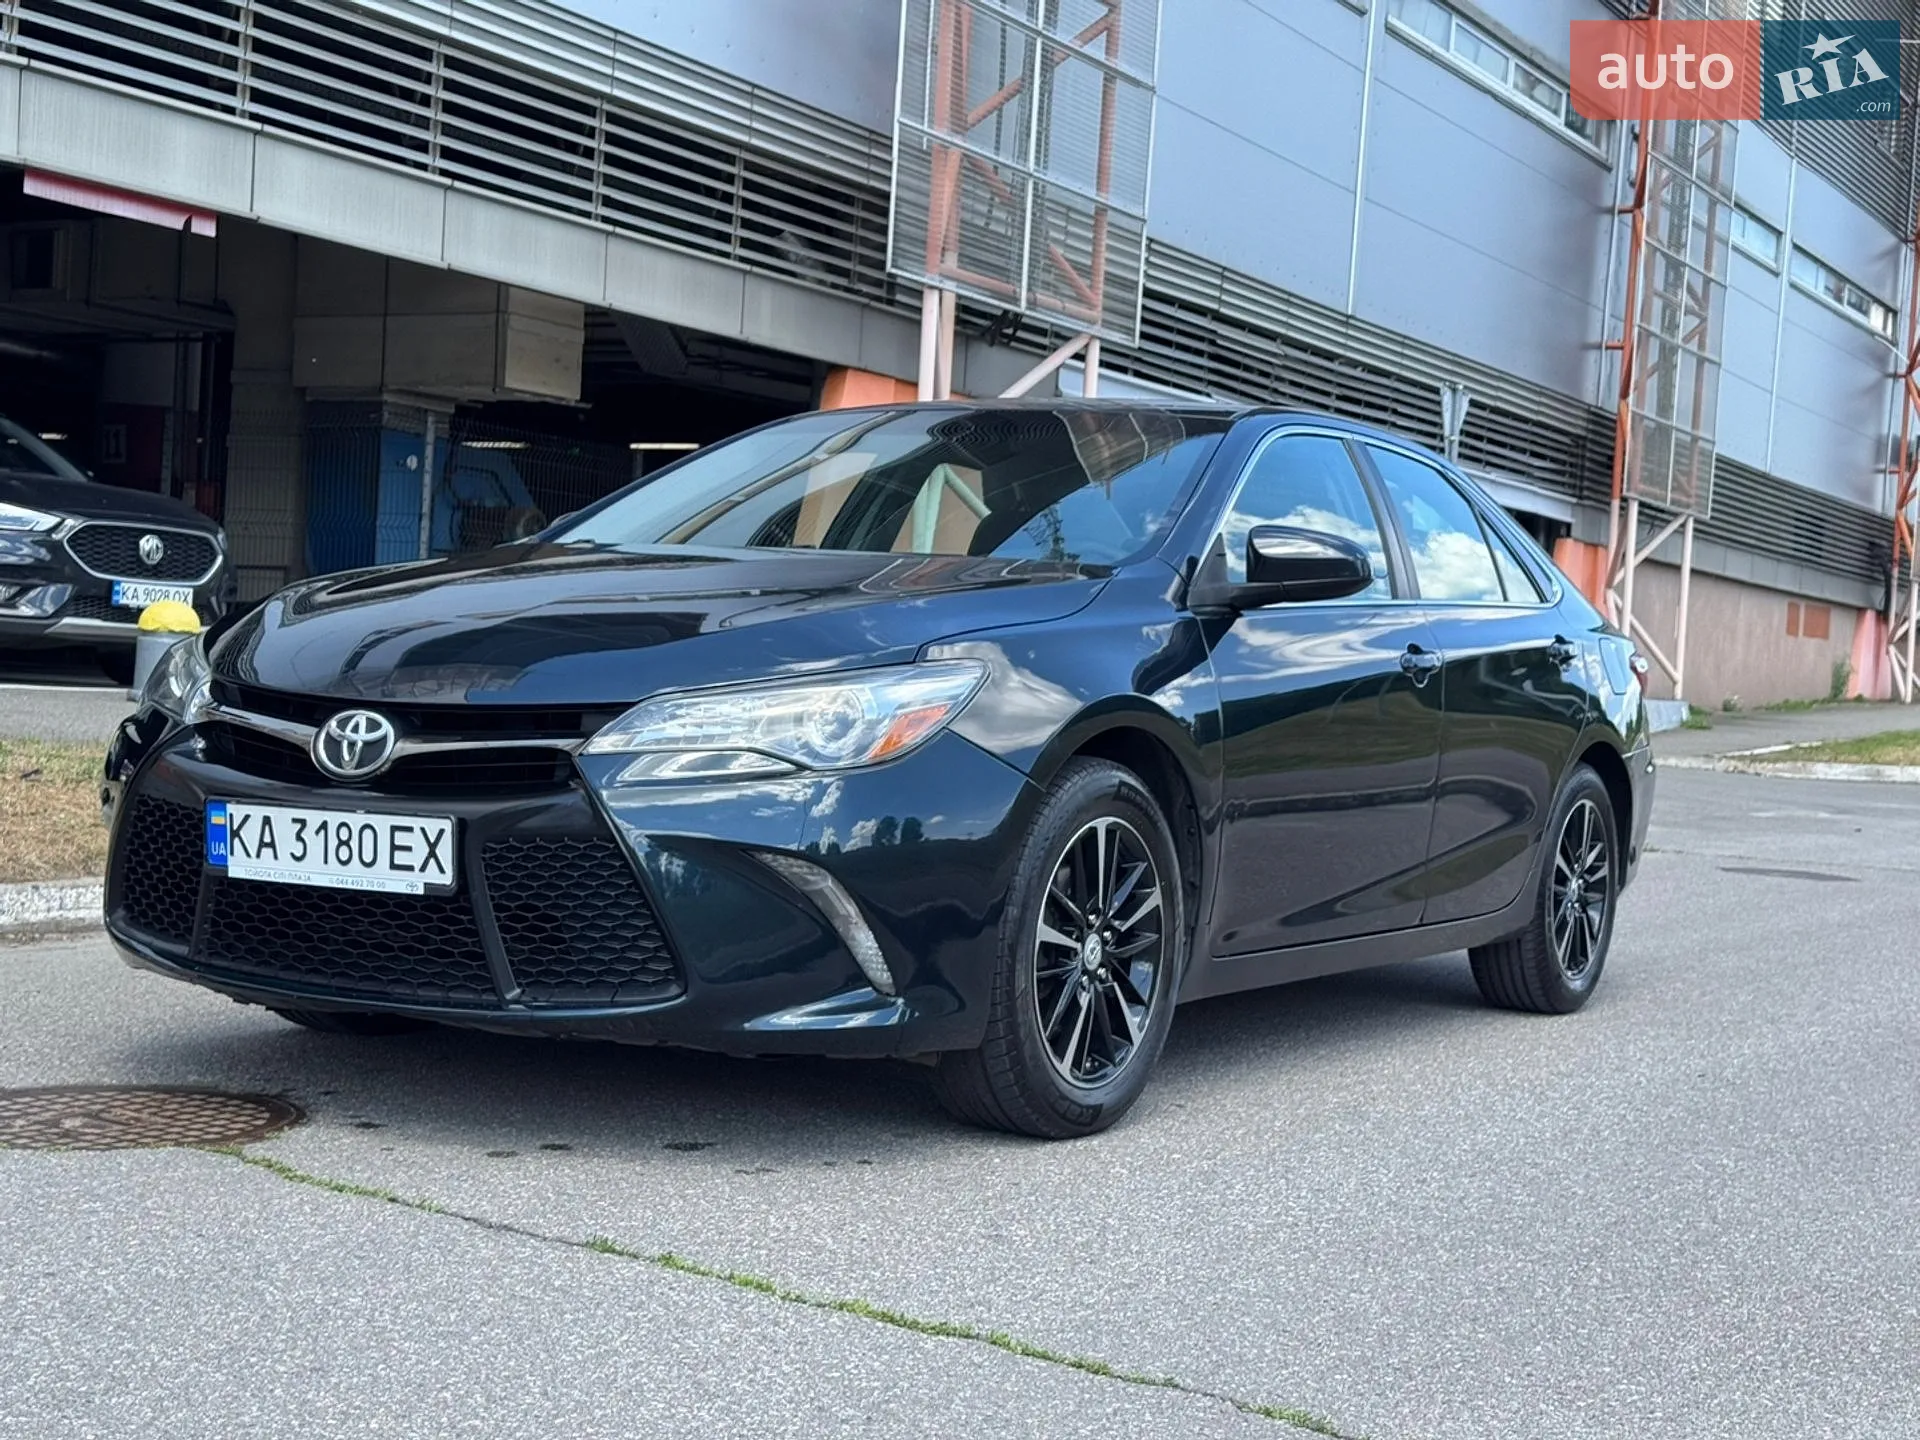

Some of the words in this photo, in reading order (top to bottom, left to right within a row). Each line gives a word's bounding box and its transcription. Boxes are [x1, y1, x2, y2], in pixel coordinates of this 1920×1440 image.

[121, 585, 139, 602] KA
[211, 841, 227, 857] UA
[229, 812, 278, 860] KA
[290, 818, 378, 868] 3180
[389, 824, 446, 874] EX
